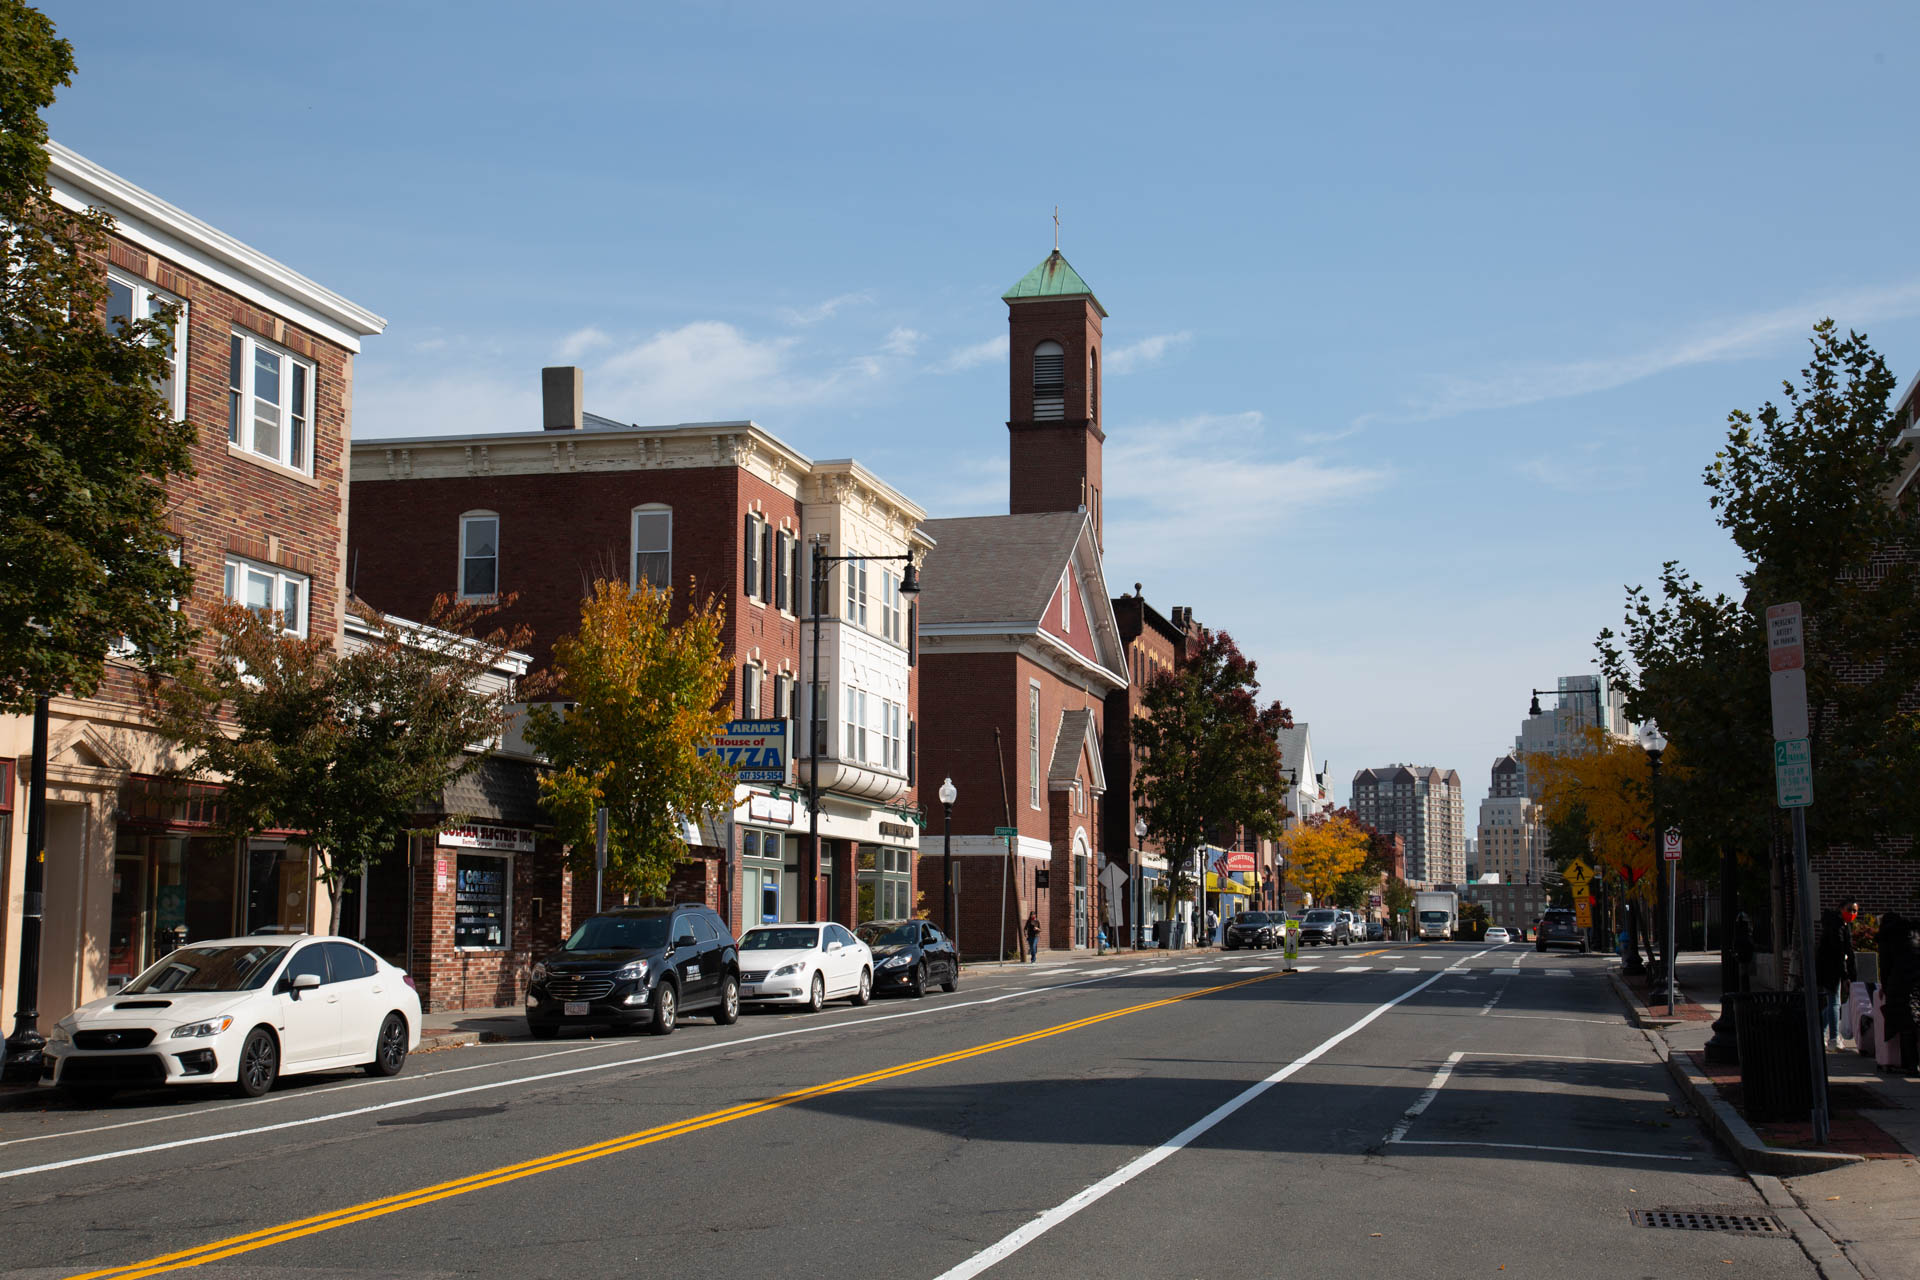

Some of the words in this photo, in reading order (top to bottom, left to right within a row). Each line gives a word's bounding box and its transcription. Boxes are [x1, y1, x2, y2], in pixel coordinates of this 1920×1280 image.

[732, 723, 780, 733] ARAM'S
[715, 737, 751, 746] House
[753, 737, 765, 746] of
[1777, 746, 1785, 762] 2
[480, 826, 517, 842] ELECTRIC
[519, 830, 533, 844] INC
